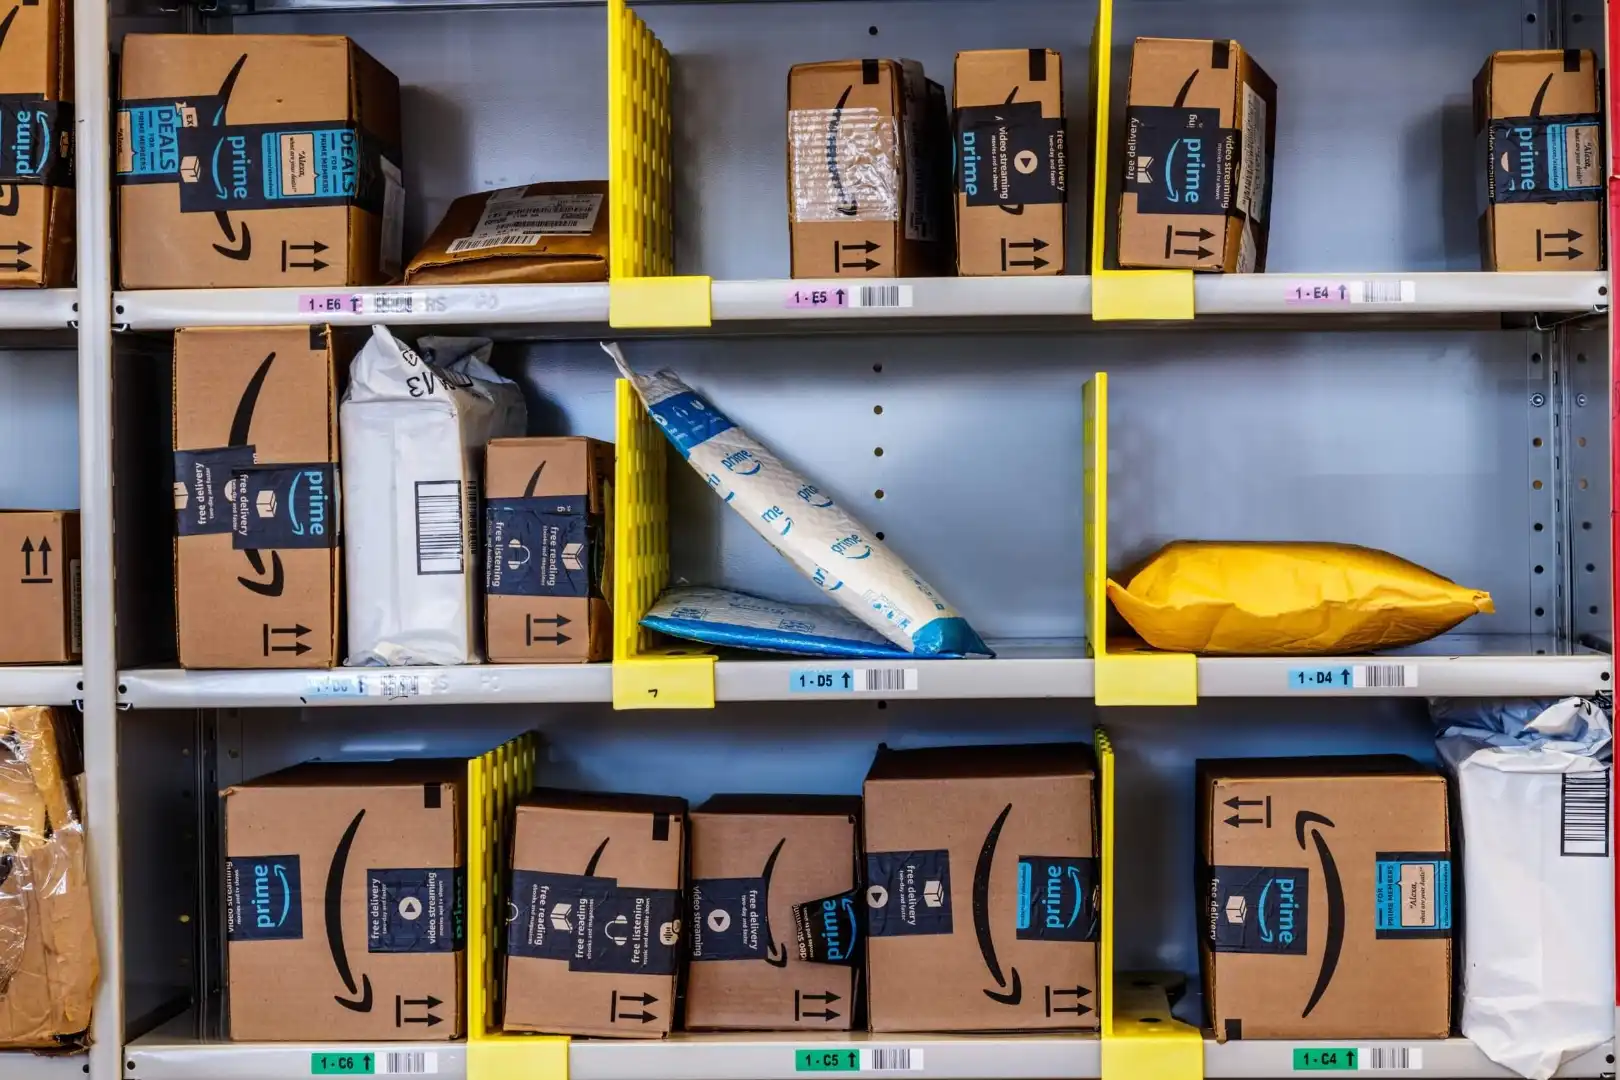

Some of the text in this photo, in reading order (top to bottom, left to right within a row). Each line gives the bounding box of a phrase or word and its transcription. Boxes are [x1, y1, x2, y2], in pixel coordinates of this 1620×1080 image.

[11, 110, 34, 174] prime
[157, 109, 176, 170] DEALS
[227, 136, 252, 199] prime
[340, 132, 355, 193] DEALS
[963, 131, 982, 196] prime
[999, 126, 1008, 152] video
[1126, 117, 1140, 180] free delivery
[1514, 127, 1539, 190] prime
[1000, 153, 1010, 199] streaming
[1057, 152, 1066, 191] delivery
[1183, 138, 1206, 203] prime
[1220, 135, 1235, 209] video streaming
[326, 298, 341, 311] E6
[812, 291, 827, 304] E5
[1313, 286, 1329, 299] E4
[721, 450, 752, 472] prime
[195, 462, 207, 525] free delivery
[239, 474, 249, 536] free delivery
[304, 471, 328, 536] prime
[492, 522, 504, 587] free listening
[547, 526, 559, 586] free reading
[830, 532, 862, 556] prime
[817, 674, 832, 687] D5
[1316, 671, 1332, 684] D4
[251, 865, 275, 928] prime
[370, 878, 381, 940] free delivery
[427, 872, 437, 944] video streaming
[534, 885, 550, 946] free reading
[693, 886, 703, 957] video streaming
[749, 889, 759, 950] free delivery
[907, 865, 917, 926] free delivery
[1041, 865, 1065, 928] prime
[1210, 878, 1220, 940] free delivery
[1275, 878, 1299, 944] prime
[575, 898, 588, 958] free reading
[631, 898, 644, 963] free listening
[821, 900, 844, 961] prime
[338, 1057, 354, 1069] C6
[823, 1054, 839, 1066] C5
[1321, 1052, 1337, 1065] C4
